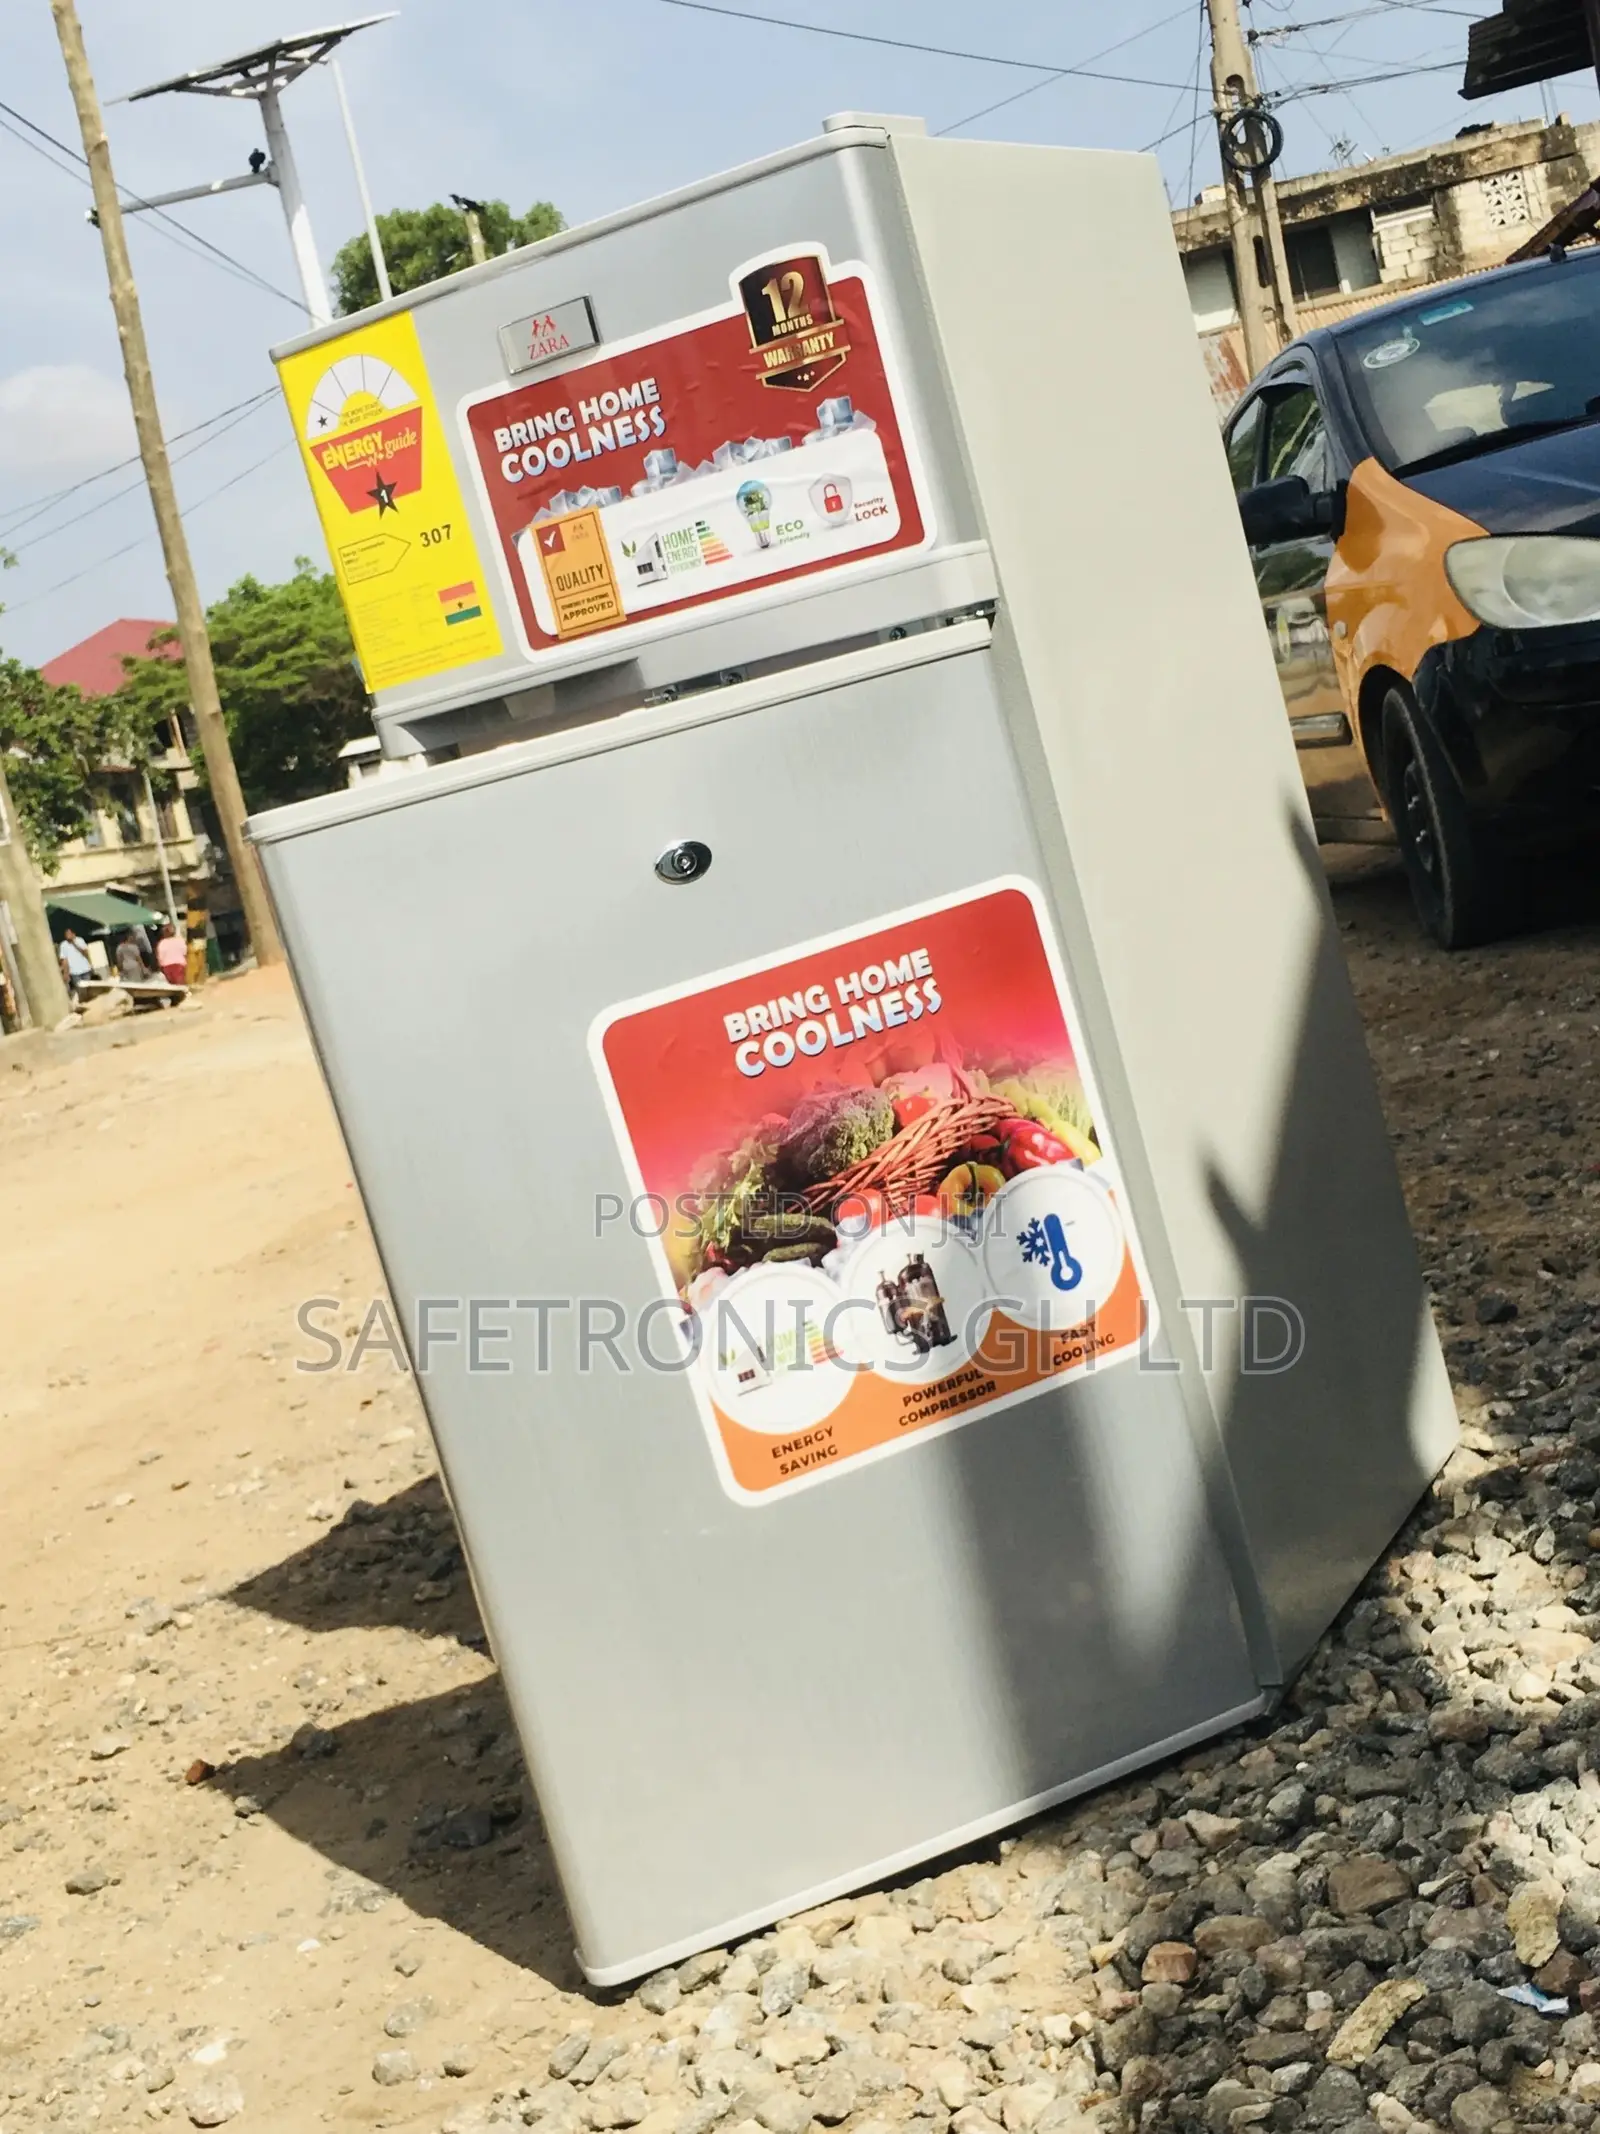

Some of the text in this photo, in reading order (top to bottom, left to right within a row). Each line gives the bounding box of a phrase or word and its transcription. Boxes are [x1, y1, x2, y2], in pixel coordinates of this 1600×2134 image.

[761, 271, 809, 324] 12
[772, 313, 813, 337] MONTHS
[527, 334, 569, 360] ZARA
[763, 331, 834, 368] WARRANTY
[493, 377, 660, 453] BRING HOME
[322, 427, 417, 471] ENERGY guide
[501, 405, 666, 483] COOLNESS
[380, 489, 389, 504] 1
[854, 497, 884, 509] Security
[776, 519, 804, 536] ECO
[855, 505, 889, 522] LOCK
[420, 524, 452, 548] 307
[662, 527, 697, 551] HOME
[555, 564, 604, 592] QUALITY
[562, 600, 614, 622] APPROVED
[723, 948, 933, 1044] BRING HOME
[735, 977, 942, 1077] COOLNESS
[1060, 1320, 1096, 1345] FAST
[1053, 1332, 1115, 1367] COOLING
[898, 1380, 996, 1427] COMPRESSOR
[902, 1368, 984, 1408] POWERFUL
[771, 1426, 834, 1460] ENERGY
[779, 1444, 838, 1475] SAVING
